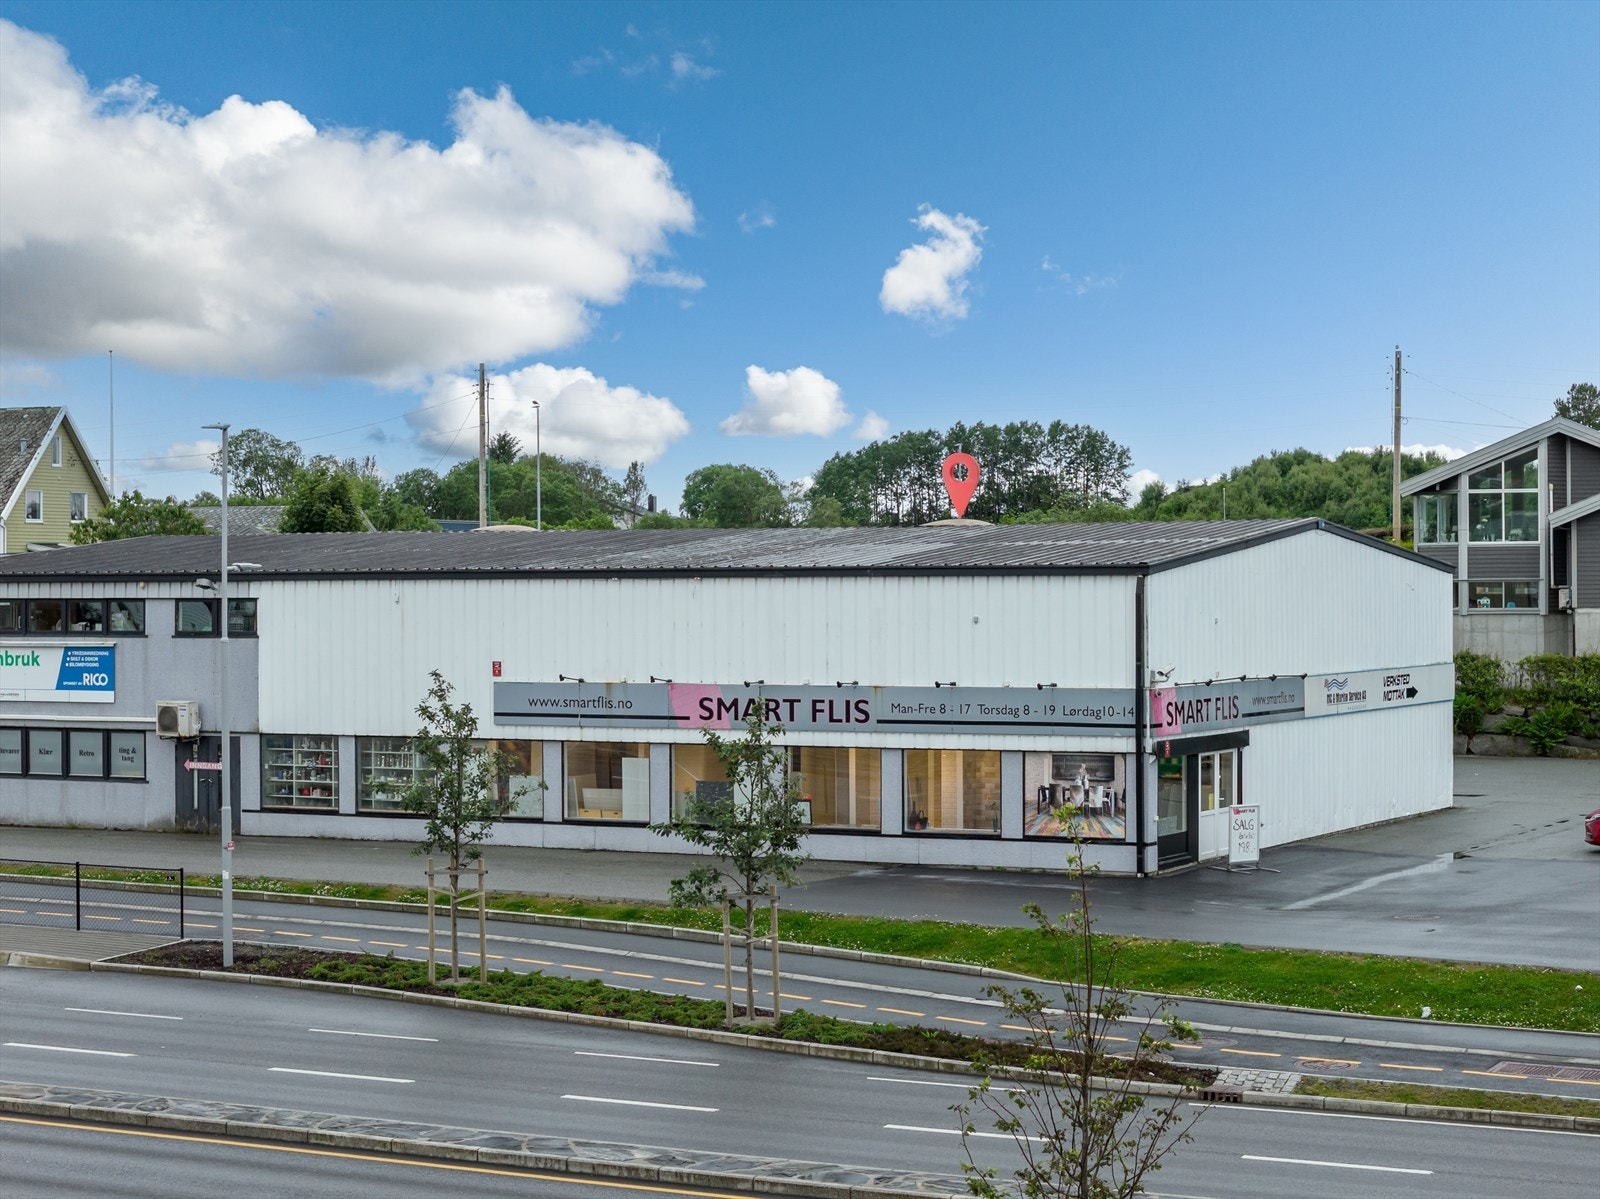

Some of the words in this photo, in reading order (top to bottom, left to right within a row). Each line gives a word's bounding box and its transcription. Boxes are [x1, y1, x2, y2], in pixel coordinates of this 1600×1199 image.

[83, 673, 109, 686] RICO
[1383, 674, 1410, 687] VERKSTED
[1252, 692, 1295, 706] www.smartflis.no
[1383, 688, 1405, 701] MOTTAK
[528, 696, 633, 709] www.smartflis.no
[699, 697, 801, 723] SMART
[811, 699, 870, 723] FLIS
[939, 703, 946, 714] 8
[960, 704, 971, 714] 17
[977, 704, 1020, 718] Torsdag
[1023, 704, 1030, 715] 8
[1044, 705, 1056, 715] 19
[1166, 698, 1211, 727] SMART
[1215, 695, 1239, 721] FLIS
[79, 749, 95, 757] Retro
[1233, 818, 1254, 830] SALG
